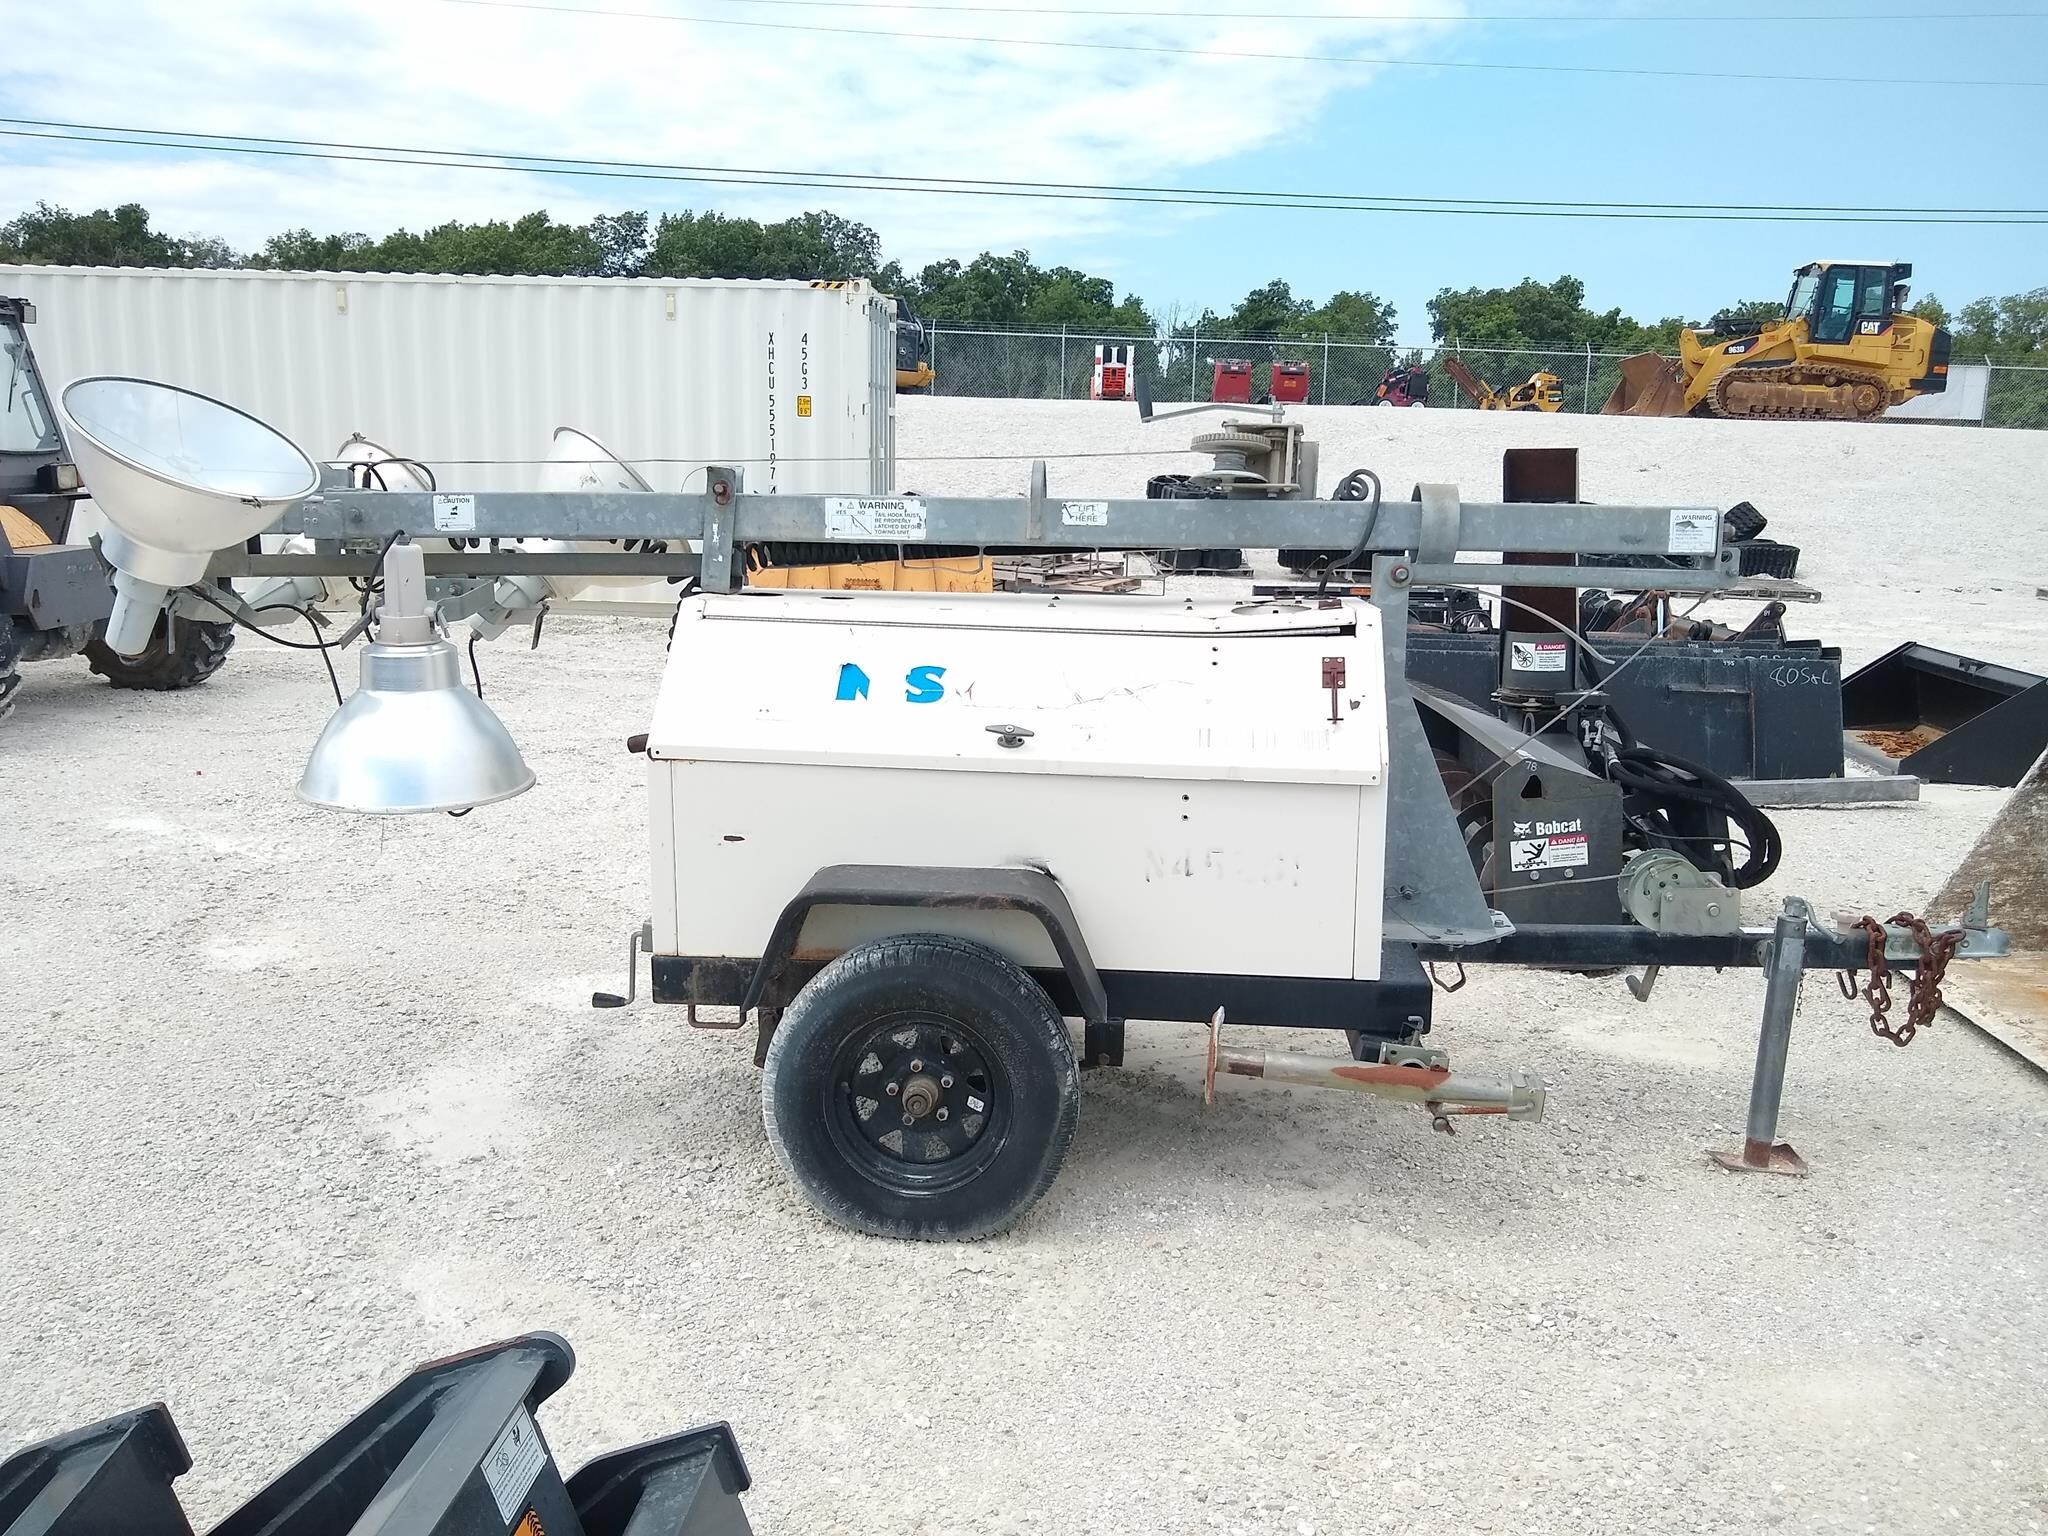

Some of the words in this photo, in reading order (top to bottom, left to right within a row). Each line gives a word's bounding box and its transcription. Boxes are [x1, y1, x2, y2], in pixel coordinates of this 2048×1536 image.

[1861, 321, 1880, 334] CAT
[858, 501, 905, 511] WARNING
[1525, 760, 1538, 772] 78
[1535, 817, 1582, 836] Bobcat
